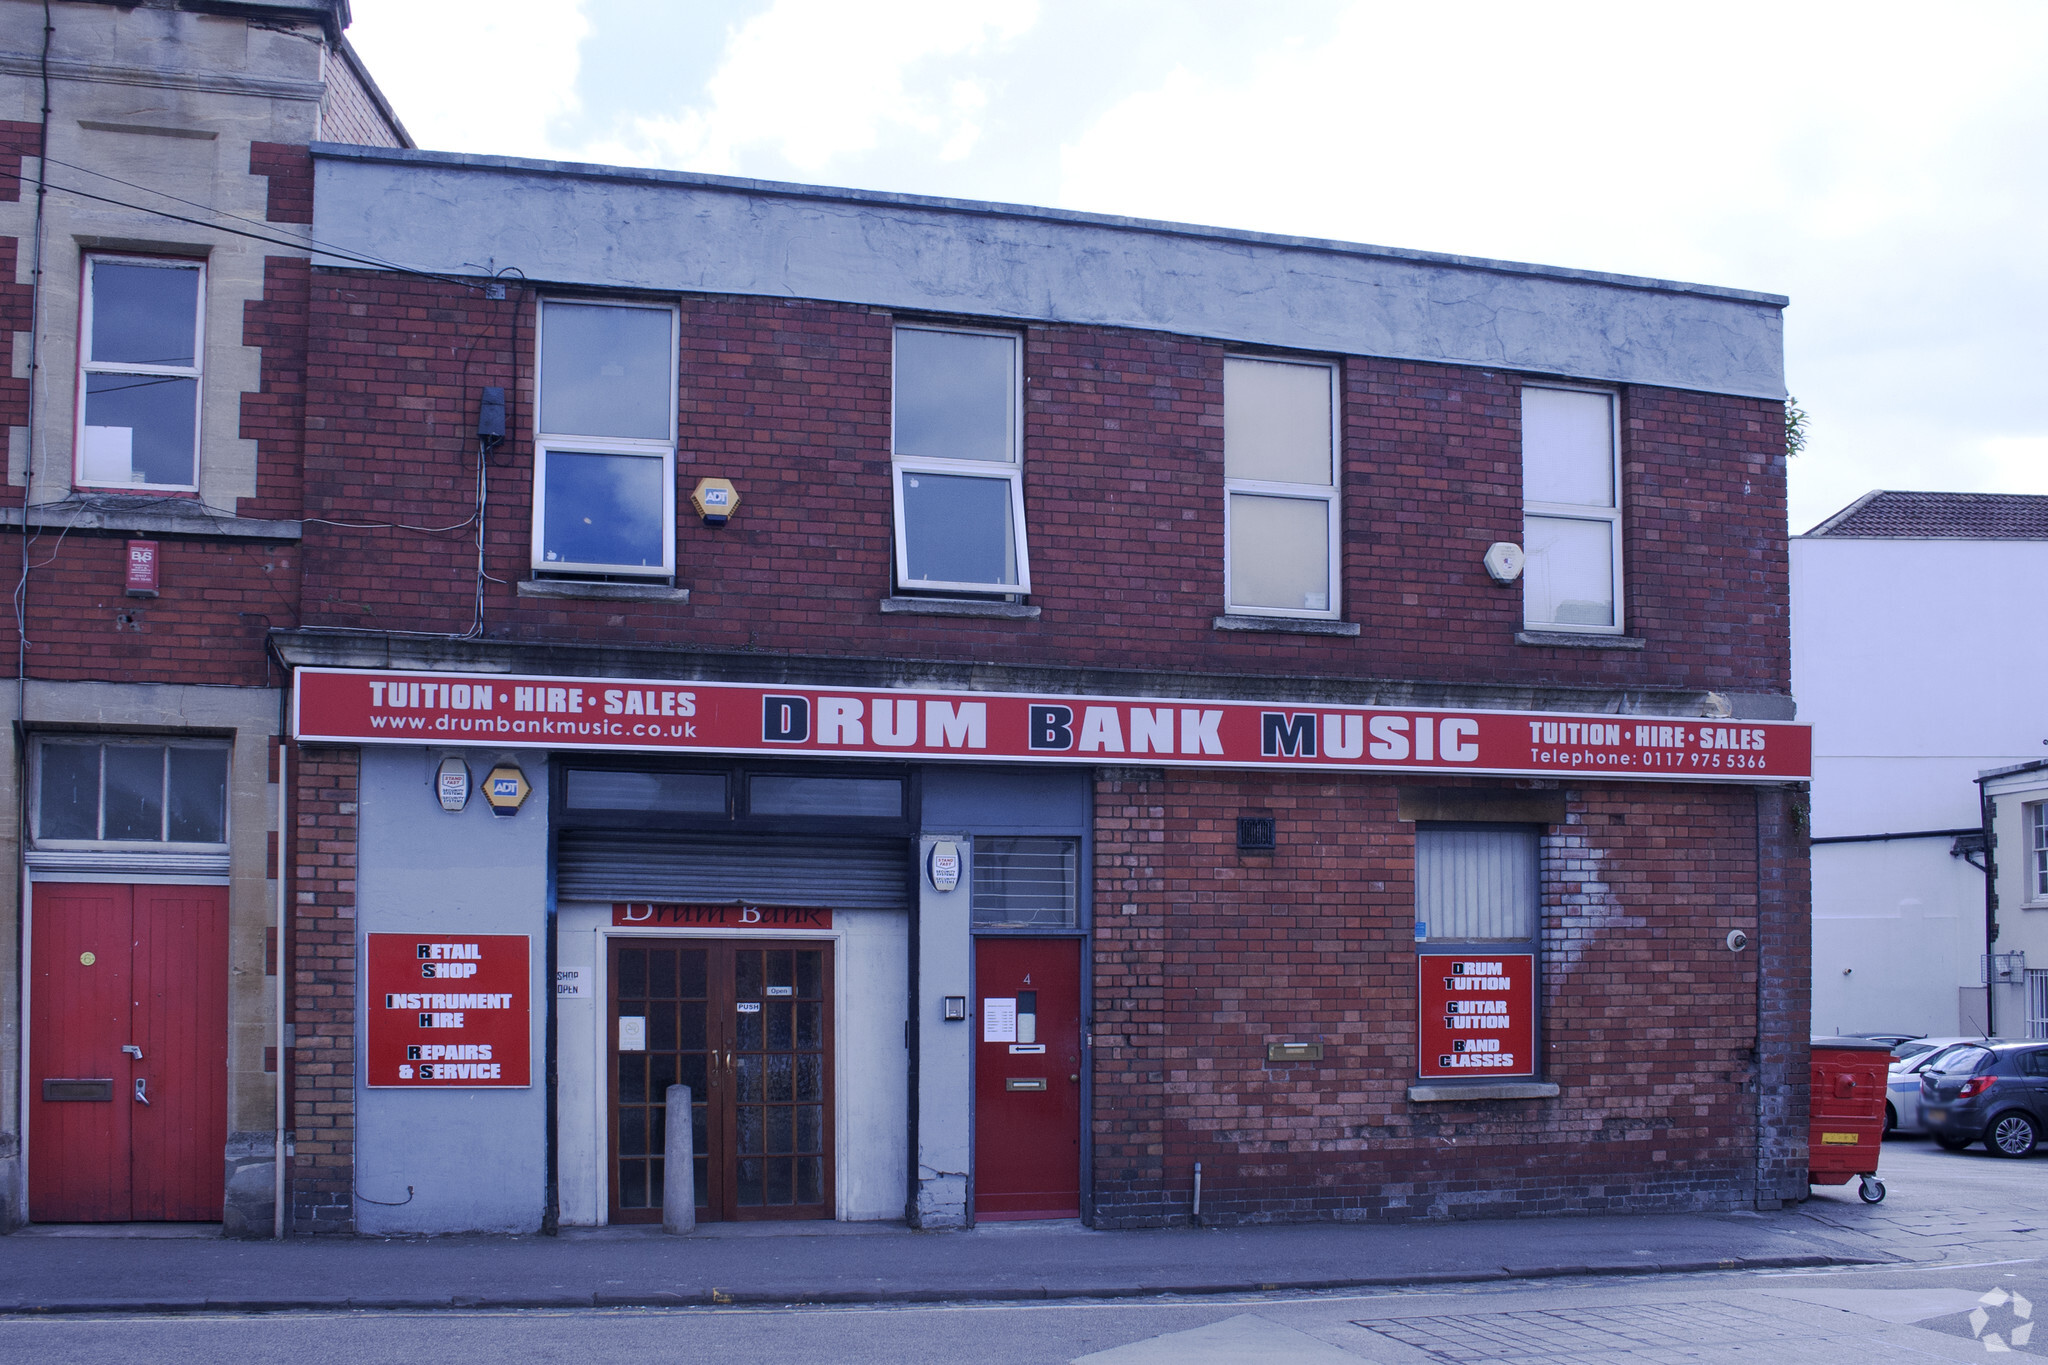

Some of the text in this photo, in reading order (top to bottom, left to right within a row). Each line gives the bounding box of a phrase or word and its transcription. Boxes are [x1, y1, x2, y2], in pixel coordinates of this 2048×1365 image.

[705, 491, 728, 502] ADT
[369, 681, 696, 717] TUITION HIRE SALES
[370, 714, 697, 738] www.drumbankmusic.co.uk
[761, 694, 1479, 763] DRUM BANK MUSIC
[1529, 721, 1766, 751] TUITION HIRE SALES
[1531, 748, 1766, 769] Telephone: 0117 975 5366
[495, 782, 518, 793] ADT
[417, 943, 482, 960] RETAIL
[421, 963, 477, 978] SHOP
[557, 971, 579, 980] SHOP
[1452, 962, 1503, 975] DRUM
[1023, 973, 1031, 985] 4
[1443, 977, 1510, 990] TUITION
[557, 984, 578, 994] OPEN
[386, 993, 512, 1009] INSTRUMENT
[1446, 1000, 1507, 1014] GUITAR
[419, 1012, 464, 1028] HIRE
[1443, 1015, 1510, 1029] TUITION
[407, 1044, 492, 1060] REPAIRS
[1453, 1039, 1500, 1052] BAND
[1439, 1053, 1514, 1068] CLASSES
[399, 1063, 501, 1079] & SERVICE
